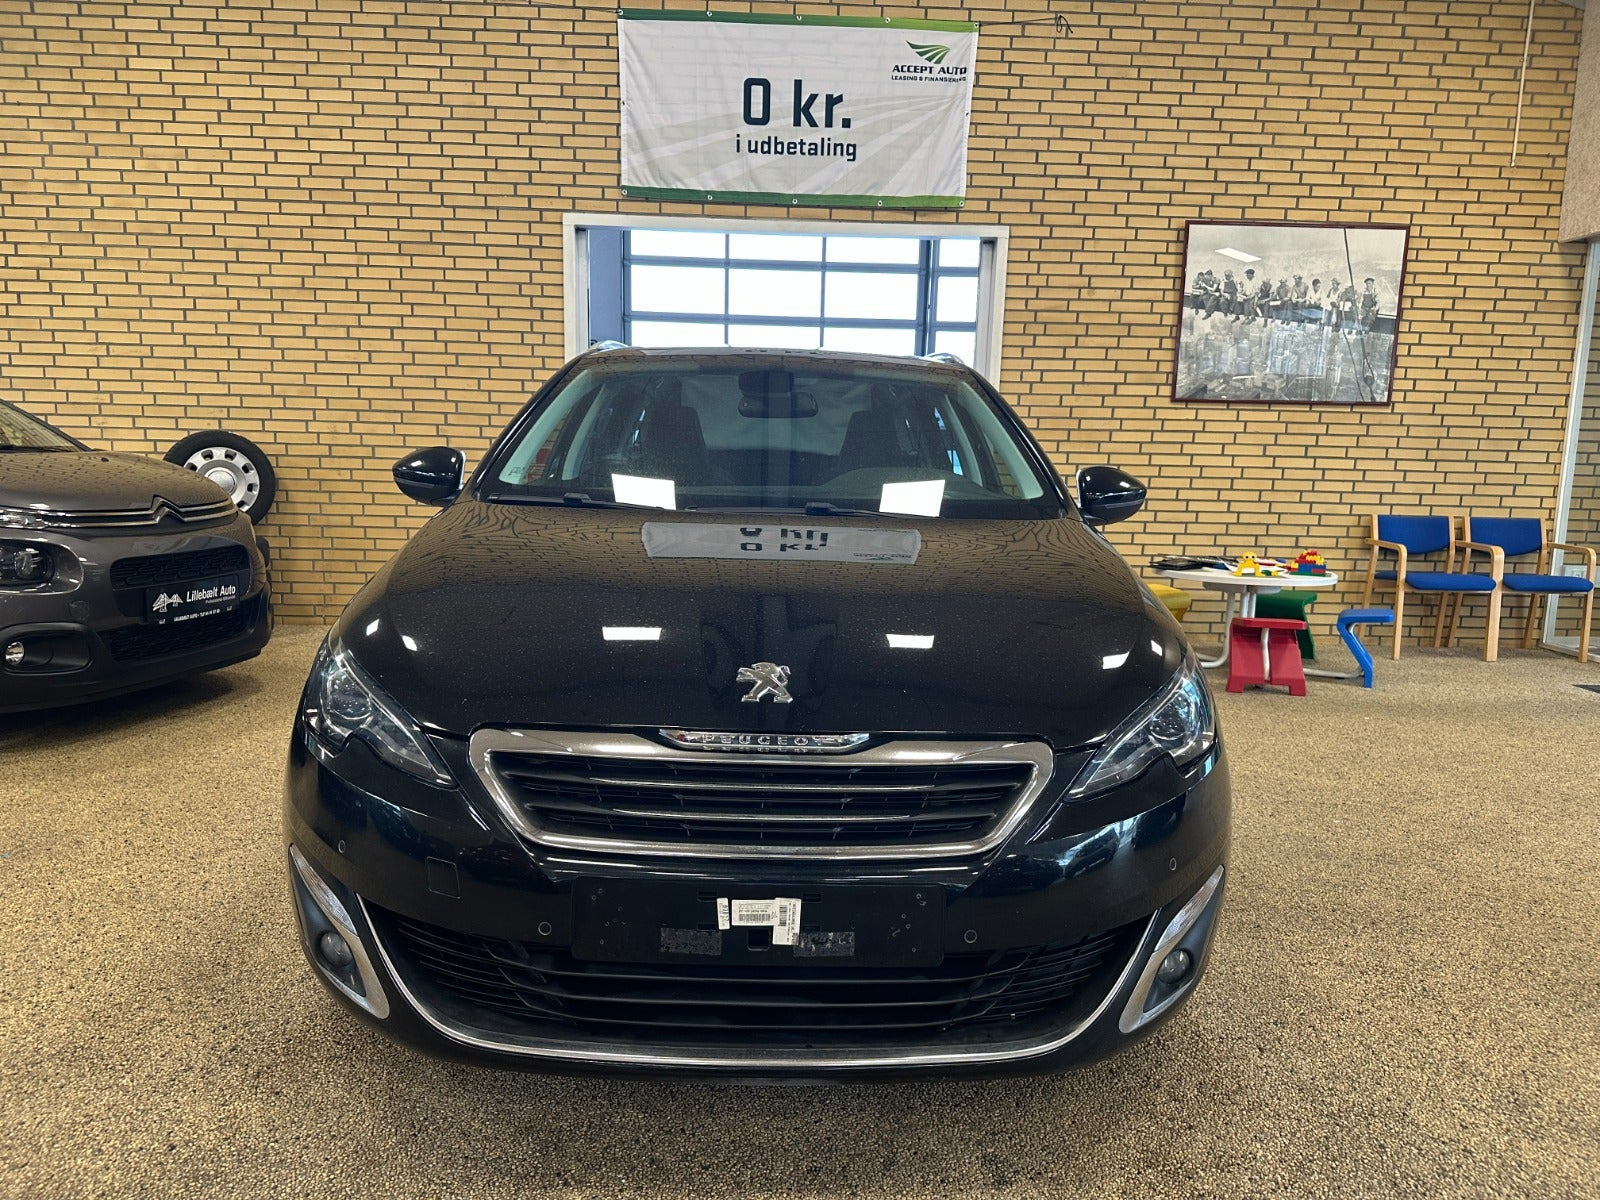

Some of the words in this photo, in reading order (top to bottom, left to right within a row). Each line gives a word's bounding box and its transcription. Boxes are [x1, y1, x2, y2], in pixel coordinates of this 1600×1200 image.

[892, 64, 934, 74] ACCEPT
[937, 66, 967, 75] AUTO
[793, 79, 852, 129] kr.
[735, 134, 741, 153] i
[747, 136, 857, 162] udbetaling
[187, 587, 218, 602] Lillebælt
[220, 585, 236, 596] Auto
[702, 734, 827, 746] PEUGEOT
